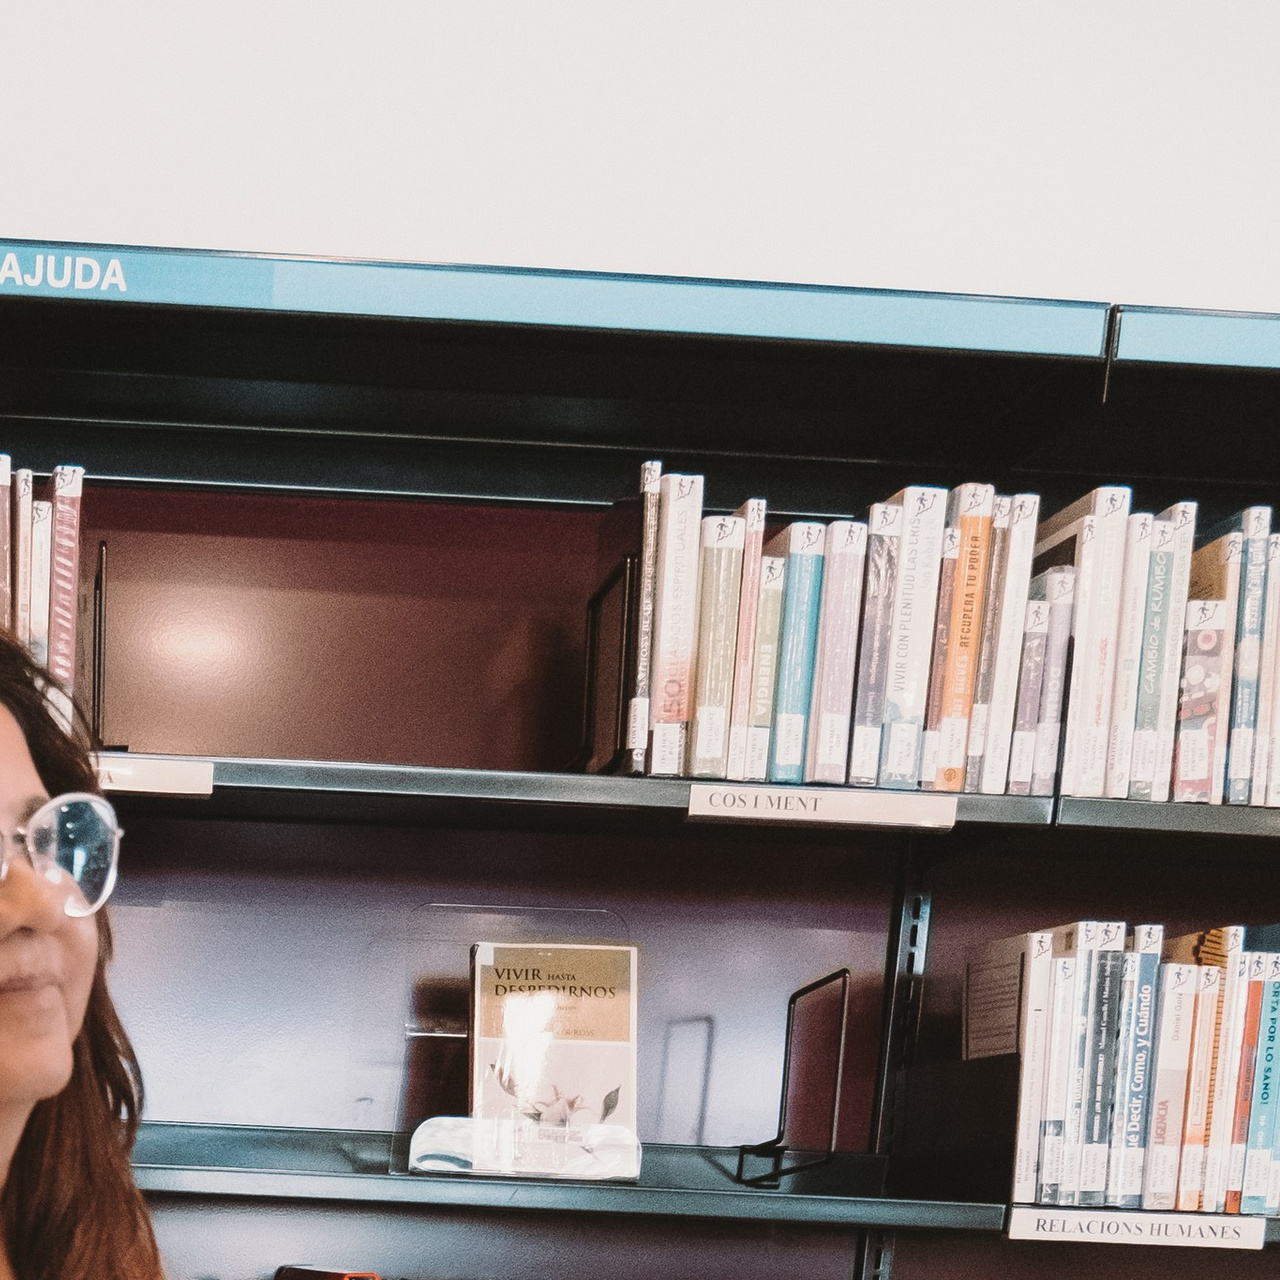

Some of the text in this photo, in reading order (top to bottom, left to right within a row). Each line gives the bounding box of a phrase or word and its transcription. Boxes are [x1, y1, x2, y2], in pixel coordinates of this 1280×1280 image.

[661, 509, 688, 715] 50 ESPIRITUALES
[892, 547, 919, 693] VIVIR CON PLENITUD LAS
[958, 534, 981, 648] RECUPERA TU PODER
[1144, 552, 1167, 694] CAMBIO de RUMBO
[756, 643, 772, 717] ENERGÍA
[708, 792, 822, 812] COS I MENT
[494, 968, 577, 982] VIVIR HASTA
[1125, 983, 1151, 1148] ué Decir, Como, y Cuándo
[1171, 1012, 1182, 1041] Daniel
[1260, 1016, 1277, 1105] POR LO SANO!
[1035, 1217, 1242, 1240] RELACIONS HUMANES
